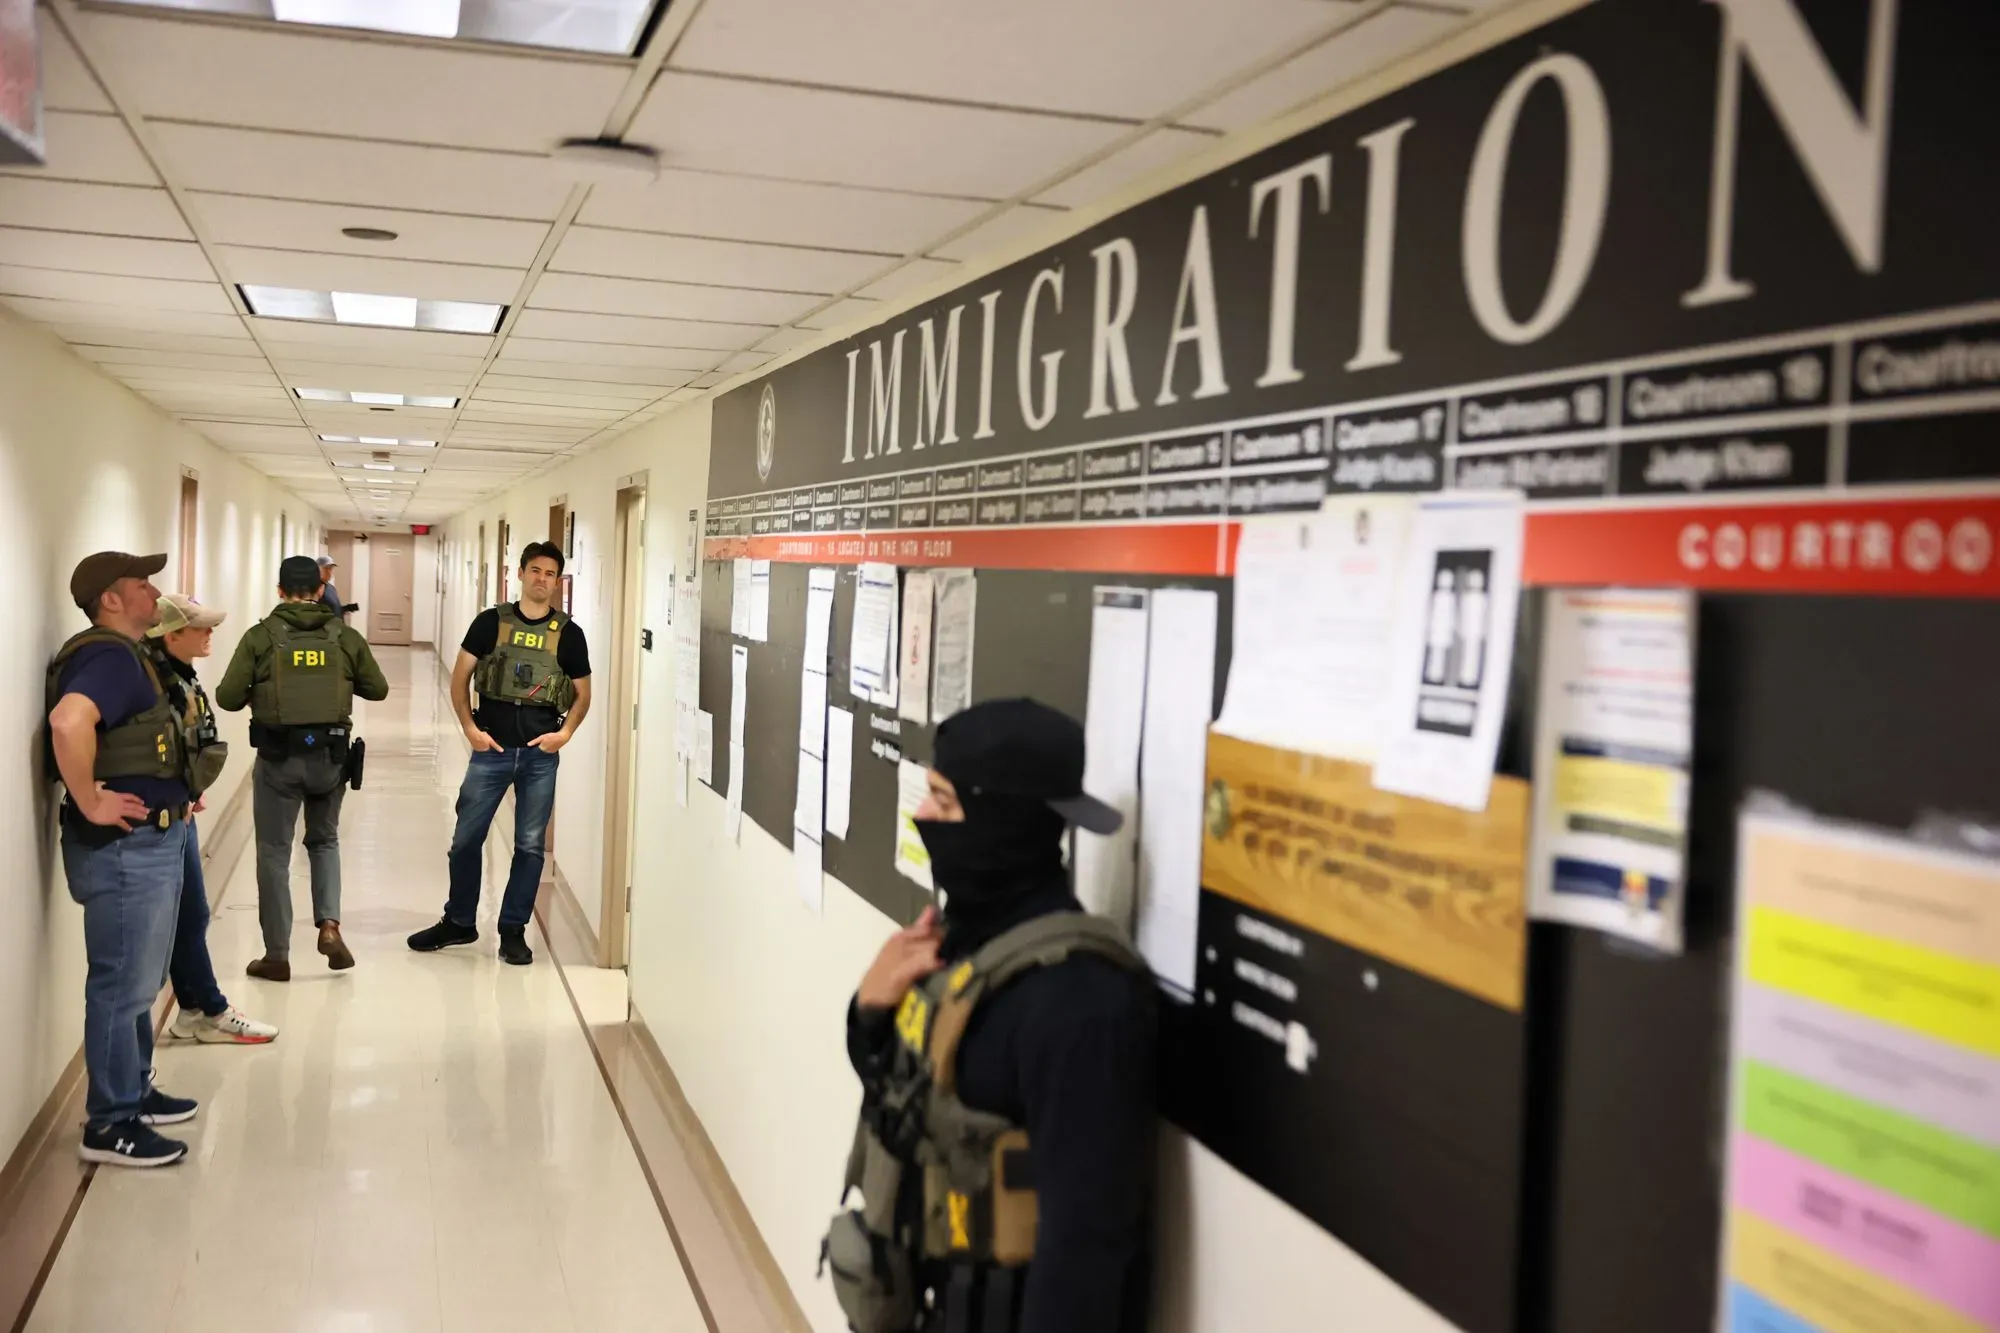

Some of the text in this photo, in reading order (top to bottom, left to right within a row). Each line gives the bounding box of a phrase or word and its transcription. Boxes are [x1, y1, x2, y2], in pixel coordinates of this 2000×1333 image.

[842, 0, 1899, 463] IMMIGRATION
[1628, 374, 1777, 418] Courtroom
[1336, 419, 1417, 450] Courtroom
[1459, 399, 1568, 438] Courtroom
[1644, 440, 1792, 490] Judge Khan
[838, 541, 865, 556] LOCATED
[882, 540, 896, 557] THE
[923, 540, 952, 558] FLOOR
[1677, 518, 2000, 576] COURTROO
[293, 651, 326, 666] FBI
[513, 631, 545, 649] FBI
